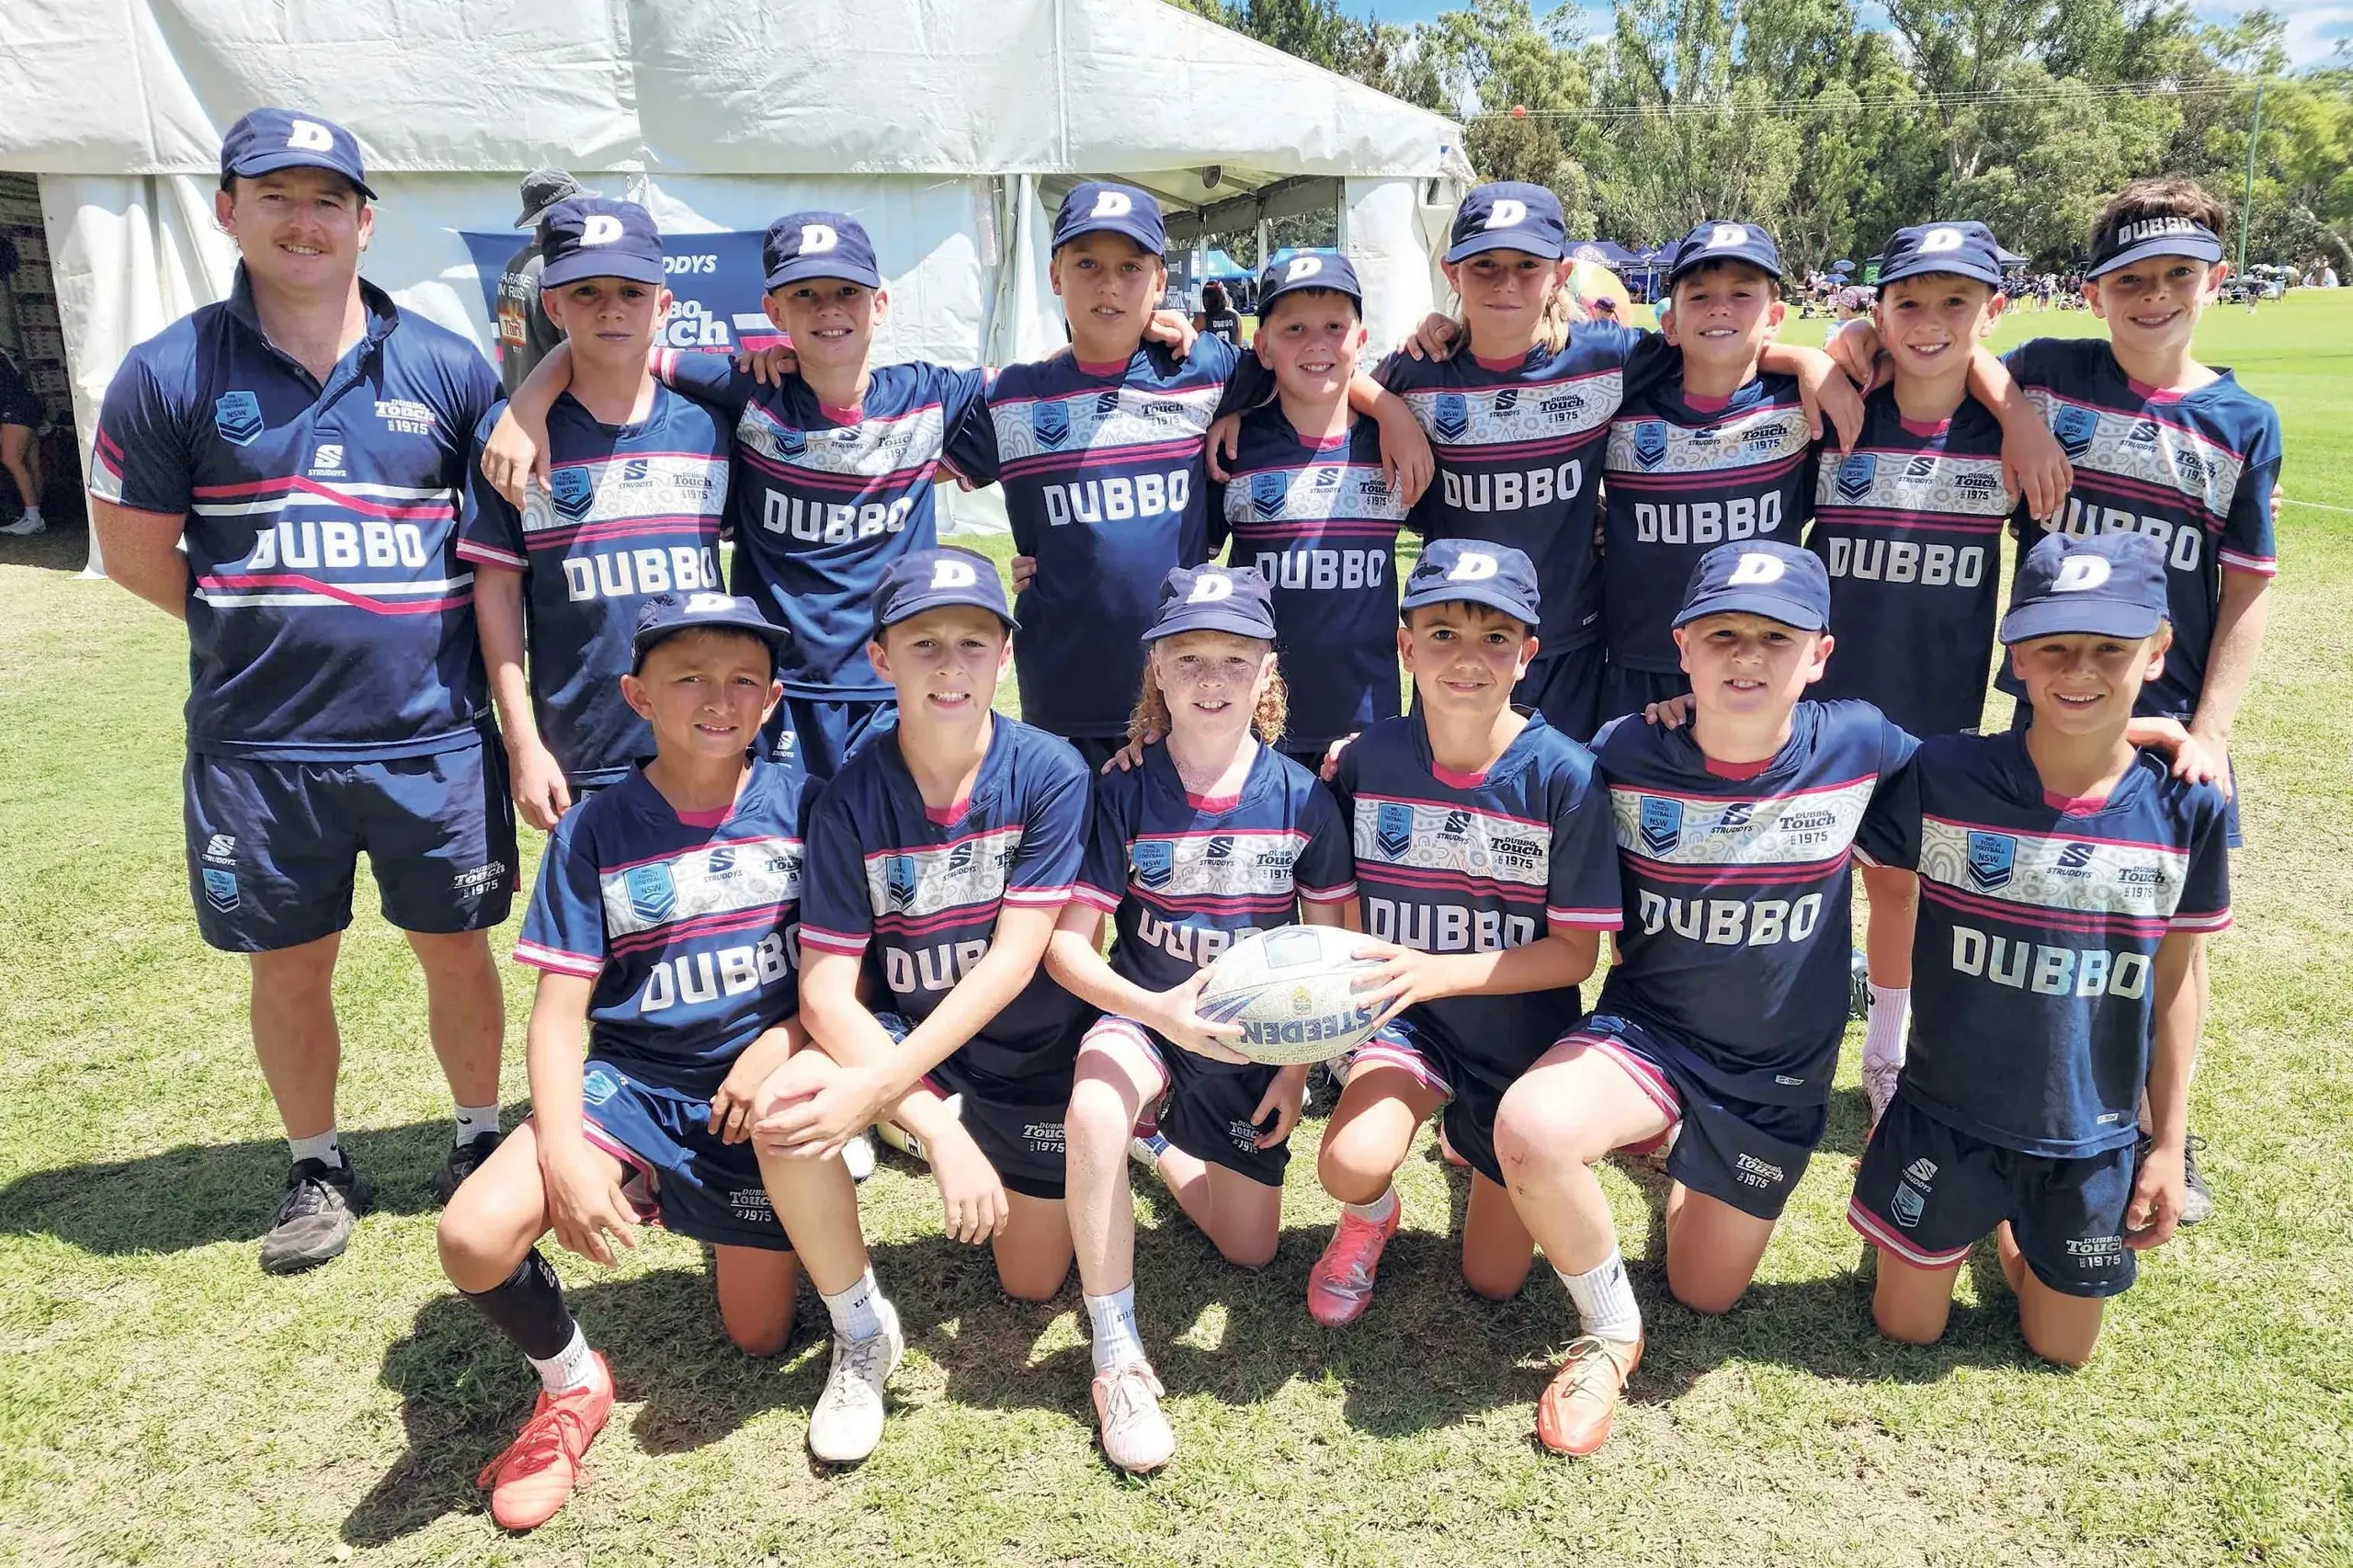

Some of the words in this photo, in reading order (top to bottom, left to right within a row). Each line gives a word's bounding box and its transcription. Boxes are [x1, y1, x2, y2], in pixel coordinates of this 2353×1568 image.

[286, 120, 335, 153] D
[1090, 191, 1132, 218] D
[1484, 199, 1526, 229] D
[580, 215, 623, 247] D
[1706, 225, 1747, 250] D
[2119, 216, 2196, 245] DUBBO
[798, 224, 837, 255] D
[1916, 229, 1963, 255] D
[662, 255, 717, 274] DDYS
[1285, 257, 1323, 282] D
[1540, 397, 1585, 412] Touch
[1551, 394, 1578, 403] DUBBO
[1142, 402, 1185, 415] Touch
[1554, 411, 1578, 423] 1975
[396, 419, 429, 436] 1975
[1741, 426, 1788, 439] Touch
[1755, 438, 1780, 449] 1975
[673, 473, 711, 487] Touch
[1441, 459, 1583, 513] DUBBO
[1954, 474, 1997, 488] Touch
[560, 485, 581, 494] NSW
[1041, 468, 1190, 527] DUBBO
[1966, 490, 1989, 500] 1975
[763, 487, 914, 545] DUBBO
[1634, 489, 1782, 544] DUBBO
[246, 521, 427, 570] DUBBO
[1256, 549, 1386, 590] DUBBO
[1447, 551, 1498, 583] D
[1727, 552, 1785, 586] D
[1827, 537, 1984, 587] DUBBO
[562, 545, 718, 602] DUBBO
[930, 559, 976, 589] D
[2051, 554, 2111, 592] D
[1185, 574, 1233, 605] D
[1646, 810, 1674, 818] FOOTBALL
[1650, 817, 1669, 827] NSW
[1779, 813, 1836, 830] Touch
[1795, 810, 1829, 820] DUBBO
[1710, 825, 1753, 834] STRUDDYS
[1798, 831, 1828, 844] 1975
[1490, 837, 1543, 857] Touch
[1505, 836, 1536, 847] DUBBO
[1975, 845, 2006, 854] FOOTBALL
[201, 853, 237, 867] STRUDDYS
[1256, 854, 1293, 866] Touc
[1506, 856, 1533, 869] 1975
[1978, 853, 2000, 863] NSW
[454, 862, 506, 888] Touch
[2046, 867, 2092, 879] STRUDDYS
[2118, 868, 2165, 884] Touch
[471, 880, 499, 897] 1975
[641, 884, 663, 893] NSW
[2131, 886, 2153, 898] 1975
[1369, 896, 1536, 952] DUBBO
[1639, 888, 1824, 947] DUBBO
[886, 939, 989, 993] DUB
[1951, 925, 2152, 1000] DUBBO
[1238, 1006, 1372, 1045] STEEDEN
[1022, 1123, 1064, 1139] Touc
[1038, 1120, 1064, 1130] DUBB
[1229, 1120, 1259, 1139] Touc
[1036, 1141, 1064, 1153] 1975
[1736, 1153, 1784, 1182] Touch
[1745, 1173, 1770, 1189] 1975
[729, 1191, 772, 1206] Touc
[744, 1210, 772, 1222] 1975
[2066, 1237, 2122, 1254] Touc
[2086, 1256, 2121, 1269] 1975
